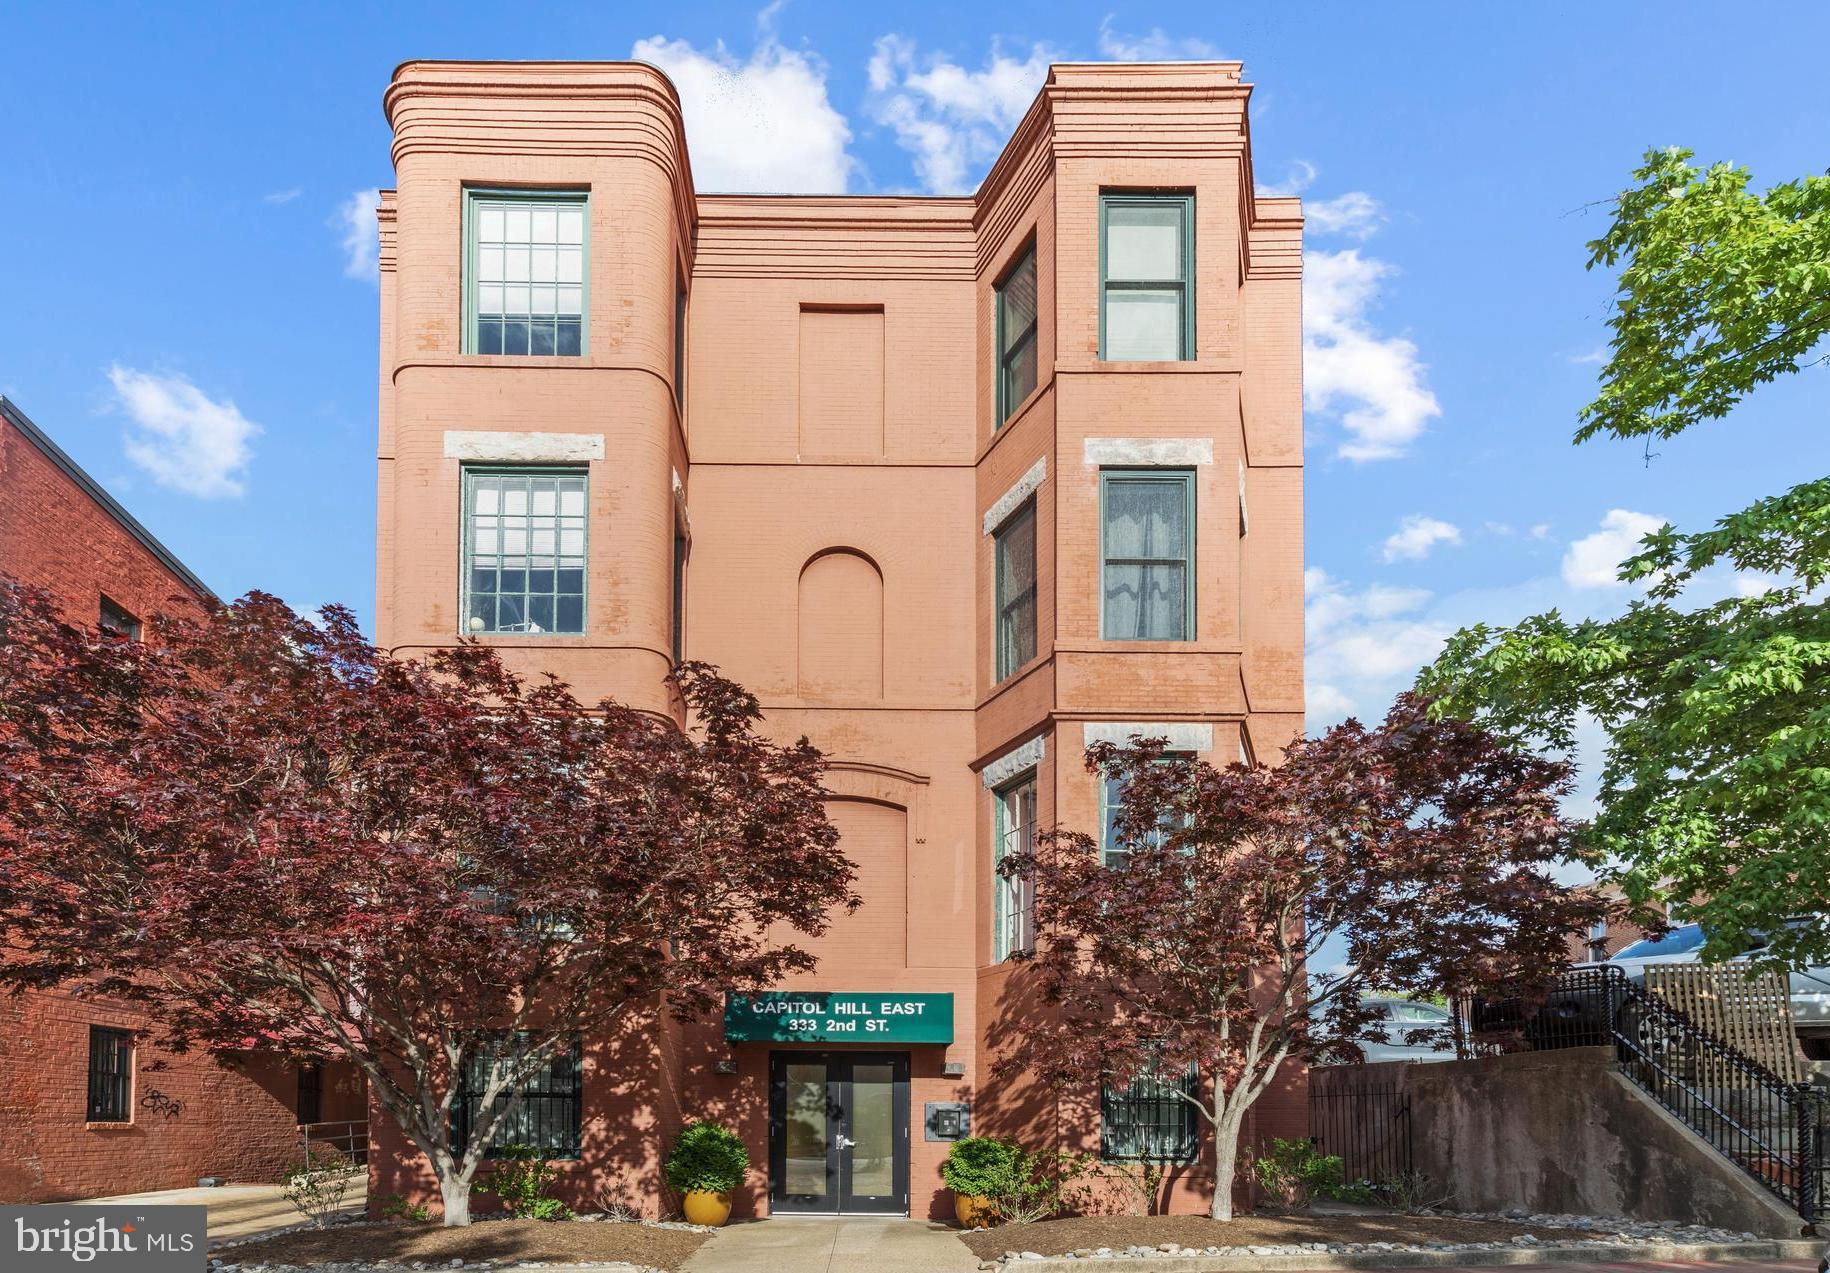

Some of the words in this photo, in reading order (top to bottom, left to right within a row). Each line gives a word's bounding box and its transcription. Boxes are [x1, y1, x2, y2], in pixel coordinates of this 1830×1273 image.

[753, 1002, 826, 1015] CAPITOL
[835, 1002, 872, 1015] HILL
[881, 1002, 926, 1015] EAST
[789, 1019, 817, 1032] 333
[826, 1019, 856, 1032] 2nd
[865, 1019, 889, 1032] ST.
